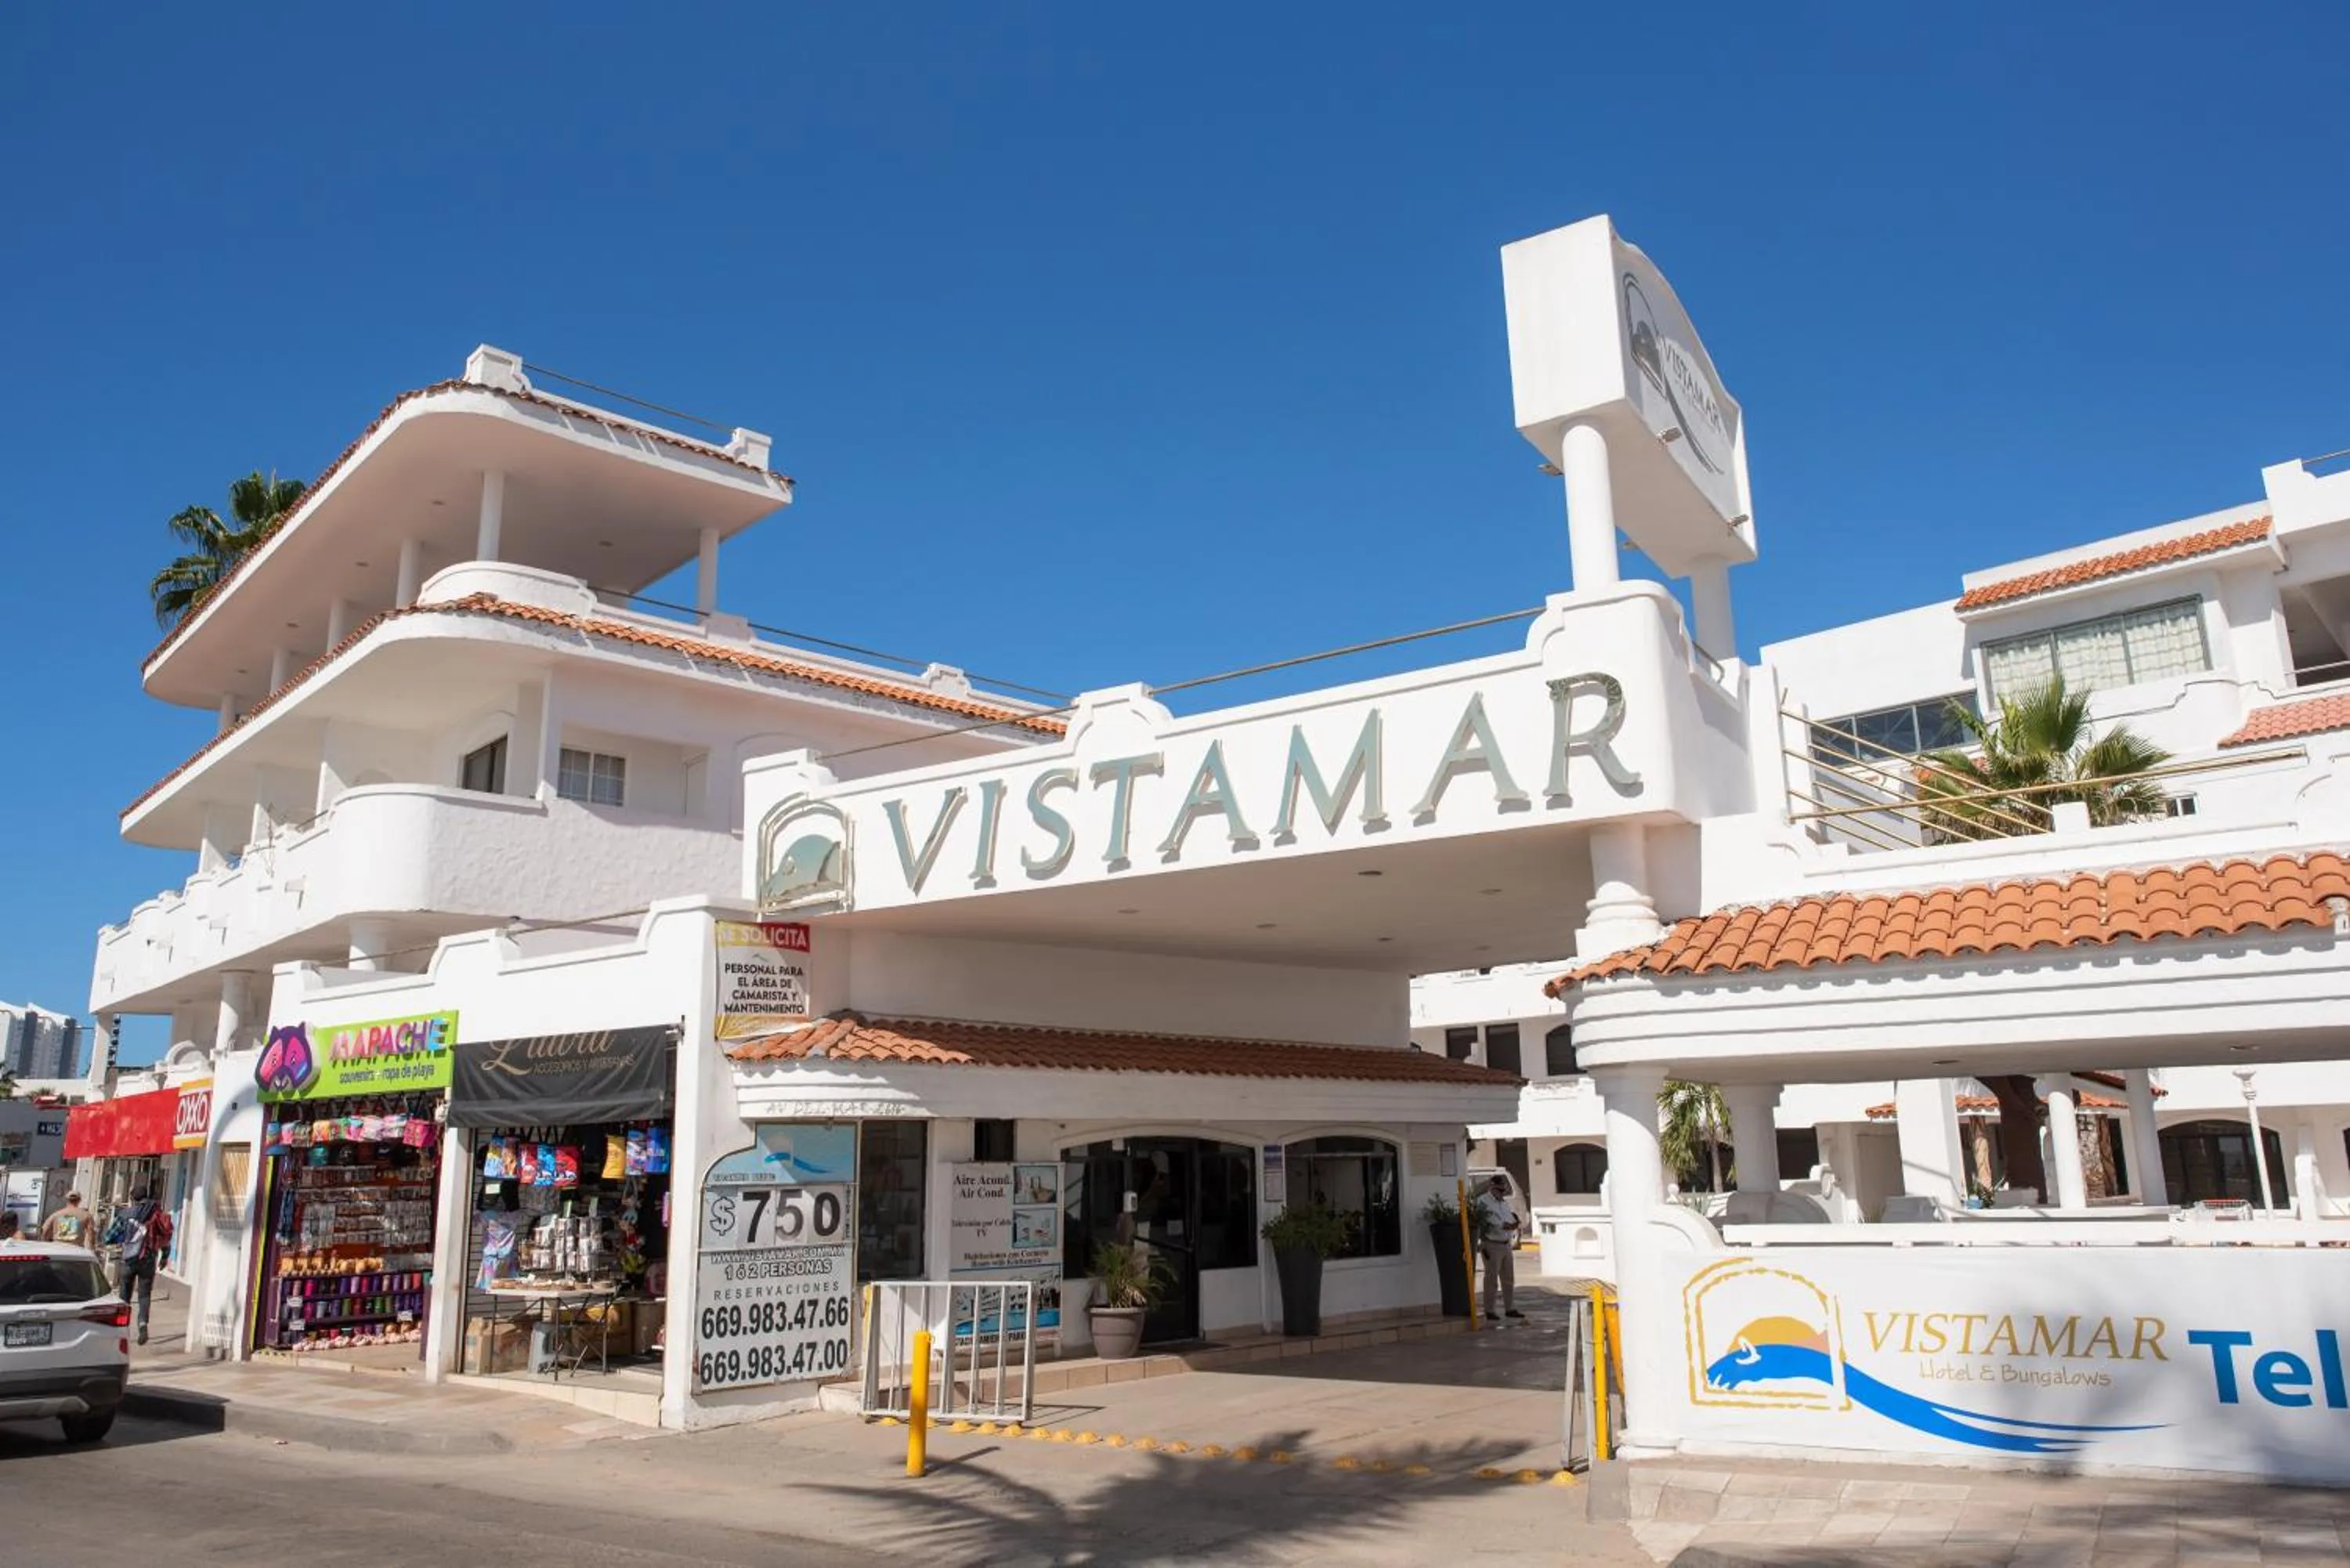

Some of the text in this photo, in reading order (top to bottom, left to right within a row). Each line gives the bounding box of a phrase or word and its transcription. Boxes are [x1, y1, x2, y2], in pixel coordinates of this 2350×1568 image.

[1661, 338, 1722, 432] VISTAMAR
[882, 670, 1643, 897] VISTAMAR
[741, 927, 807, 947] SOLICITA
[725, 963, 803, 976] PERSONAL PARA
[738, 974, 791, 988] EL ÁREA DE
[732, 990, 797, 1001] CAMARISTA Y
[724, 1003, 804, 1014] MANTENIMIENTO
[330, 1018, 447, 1061] MAPACHE
[339, 1068, 374, 1085] souvenirs
[402, 1064, 411, 1078] de
[412, 1063, 436, 1081] playa
[176, 1092, 208, 1135] OXXO
[954, 1175, 976, 1185] Aire
[960, 1188, 974, 1198] Air
[725, 1264, 732, 1281] 1
[748, 1263, 759, 1279] 2
[760, 1258, 833, 1278] PERSONAS
[714, 1281, 840, 1301] RESERVACIONES
[702, 1296, 848, 1339] 669.983.47.66
[1863, 1311, 2170, 1361] VISTAMAR
[700, 1339, 848, 1385] 669.983.47.00
[1919, 1357, 2112, 1387] Hotel & Bungalows
[2187, 1329, 2348, 1408] Tel
